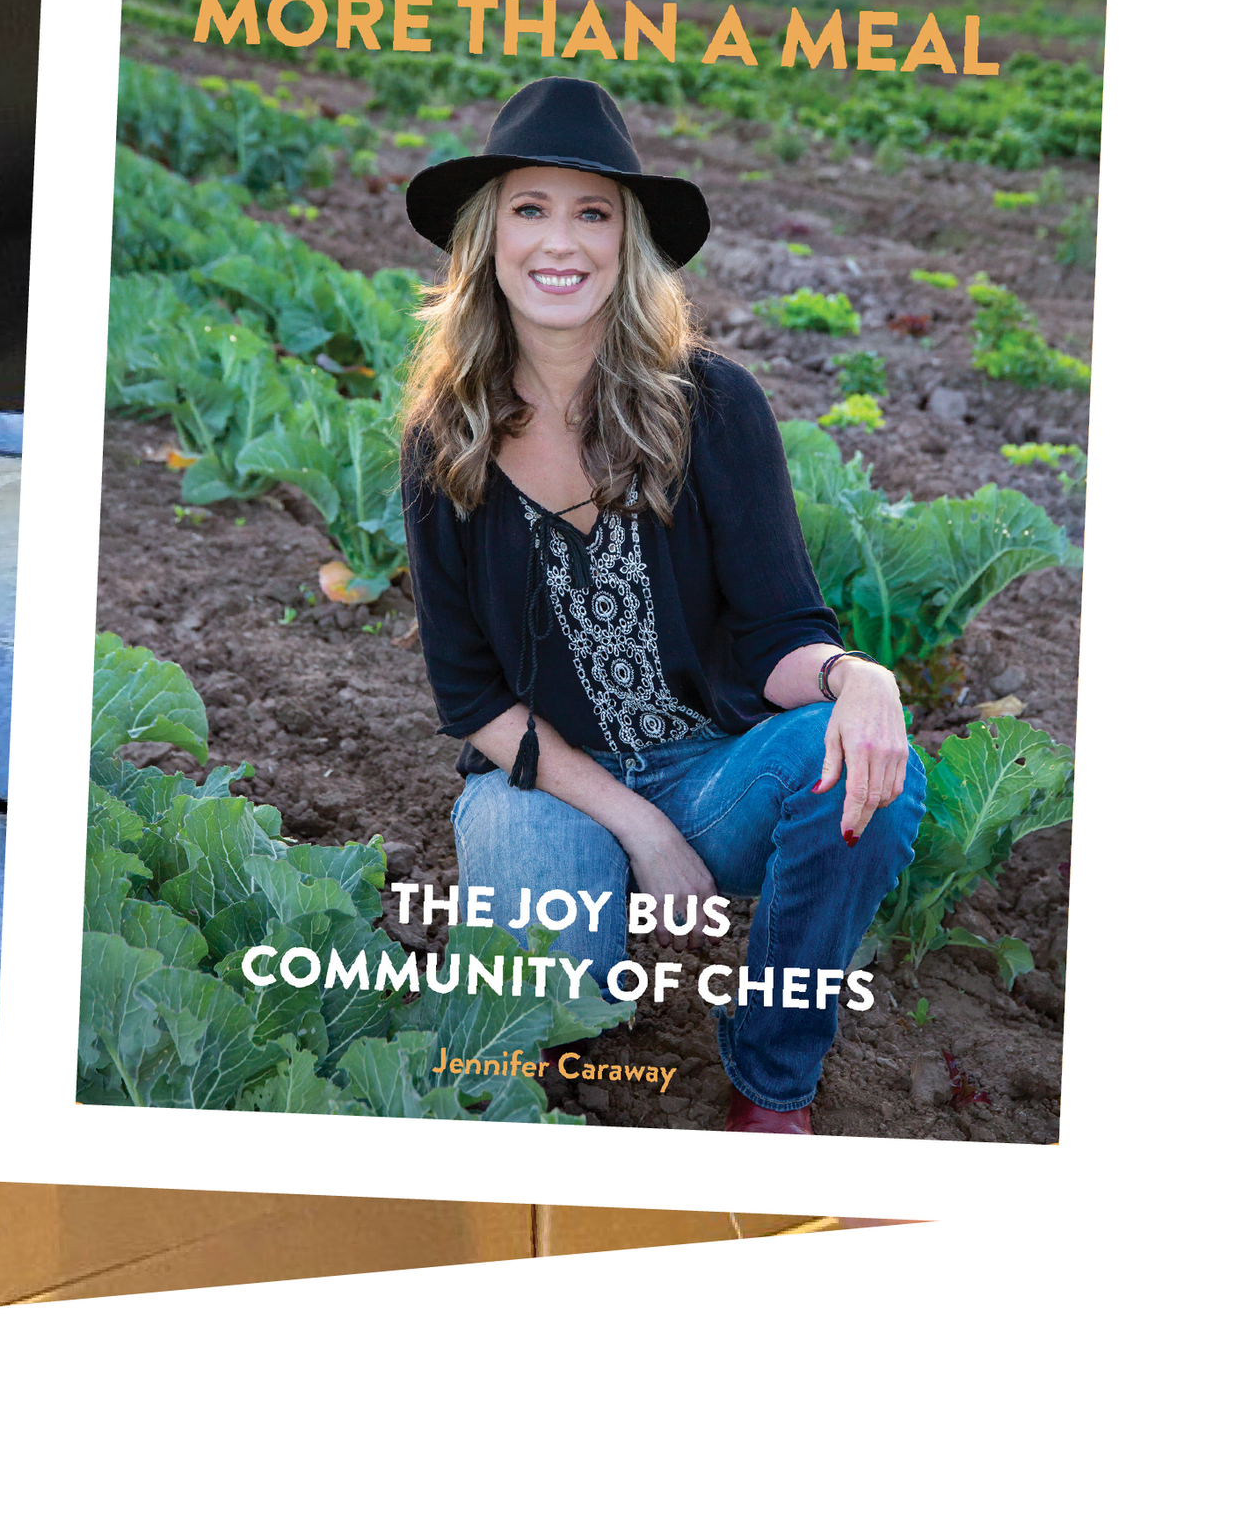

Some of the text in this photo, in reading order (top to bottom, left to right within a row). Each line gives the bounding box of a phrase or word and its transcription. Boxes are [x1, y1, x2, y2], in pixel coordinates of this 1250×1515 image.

[700, 4, 759, 66] A
[780, 7, 1000, 76] MEAL
[391, 882, 731, 938] THE JOY BUS
[241, 945, 875, 1012] COMMUNITY OF CHEFS
[432, 1047, 677, 1093] Jennifer Caraway
